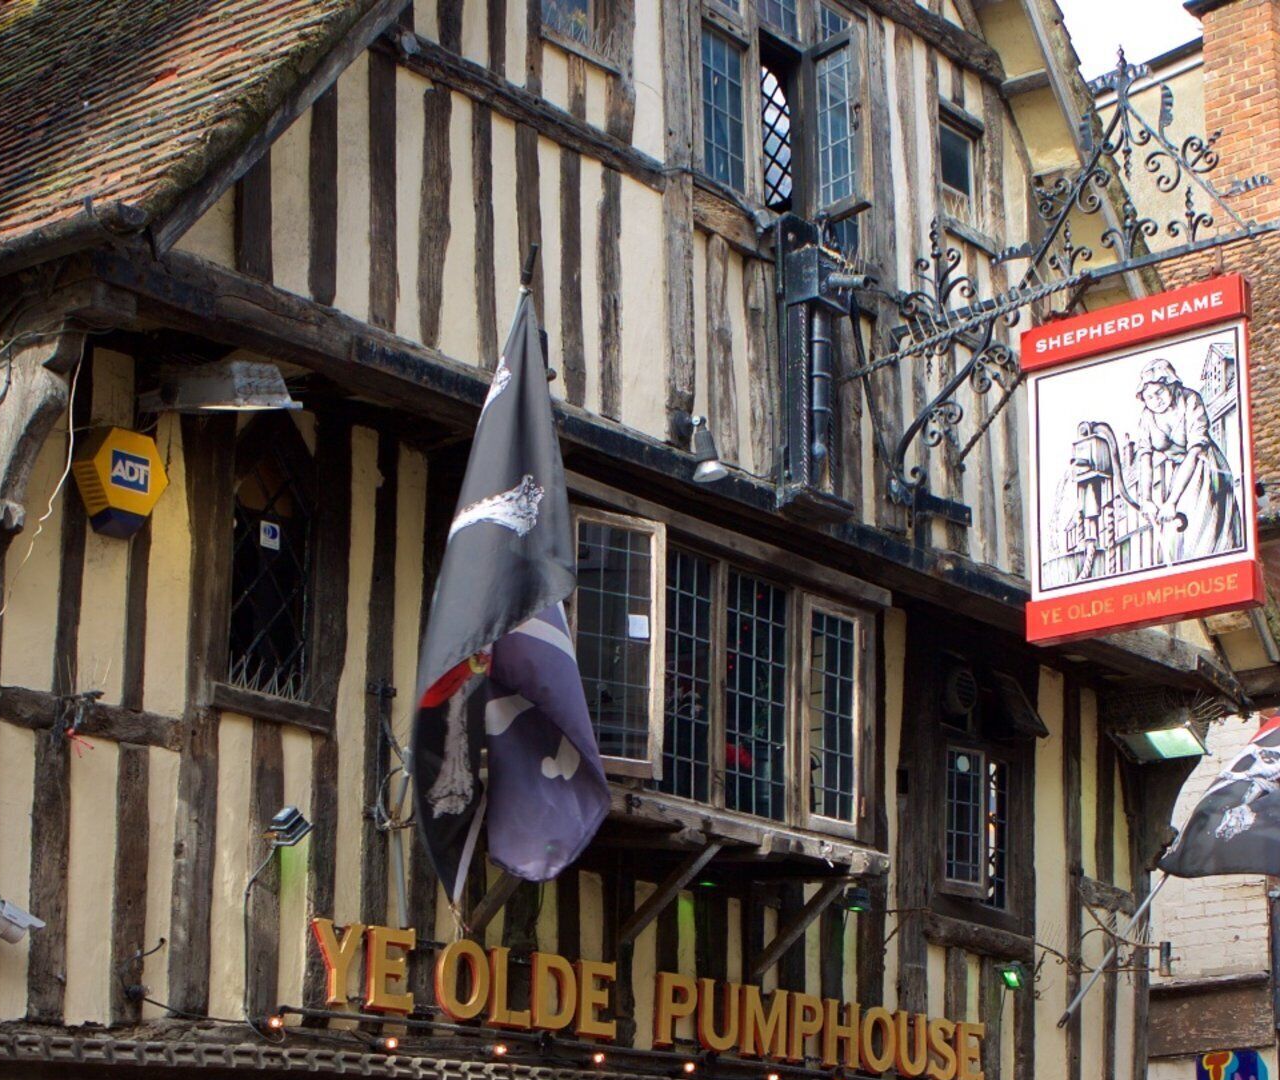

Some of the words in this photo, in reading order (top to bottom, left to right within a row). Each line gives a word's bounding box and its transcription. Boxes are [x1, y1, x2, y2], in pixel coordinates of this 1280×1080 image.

[1035, 312, 1145, 353] SHEPHERD
[1150, 291, 1224, 324] NEAME
[111, 459, 150, 486] ADT
[1040, 607, 1062, 626] YE
[1068, 598, 1115, 622] OLDE
[1121, 573, 1239, 611] PUMPHOUSE
[311, 917, 417, 1014] YE
[433, 938, 619, 1041] OLDE
